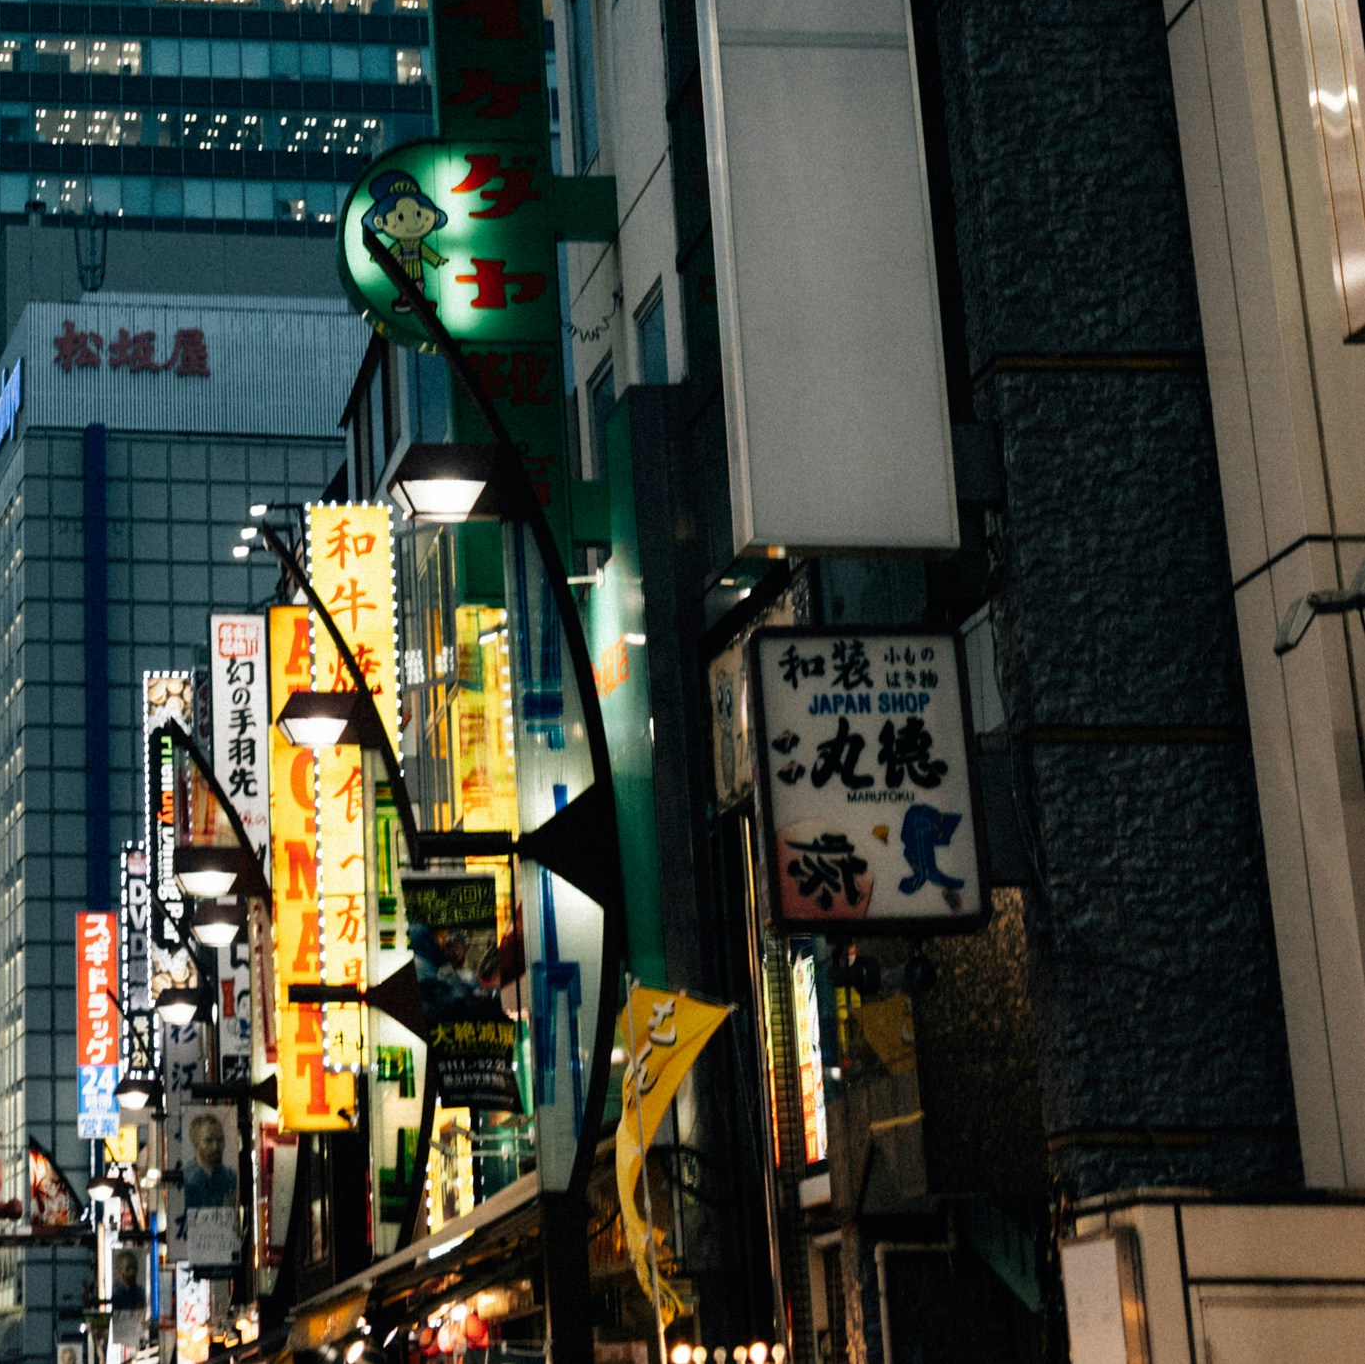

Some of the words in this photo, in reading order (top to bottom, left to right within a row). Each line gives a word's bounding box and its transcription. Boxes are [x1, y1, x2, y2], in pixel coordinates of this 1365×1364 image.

[54, 319, 211, 378] 松坂屋
[779, 639, 874, 690] 和装
[884, 646, 934, 666] 小もの
[886, 669, 938, 688] はき物
[808, 692, 871, 715] JAPAN
[878, 692, 931, 714] SHOP
[226, 660, 257, 797] 幻の手羽先
[811, 716, 948, 789] 丸徳
[847, 791, 915, 803] MARUTOKU
[85, 914, 113, 1065] スギドラッグ
[81, 1066, 116, 1096] 24
[81, 1120, 118, 1137] 営業
